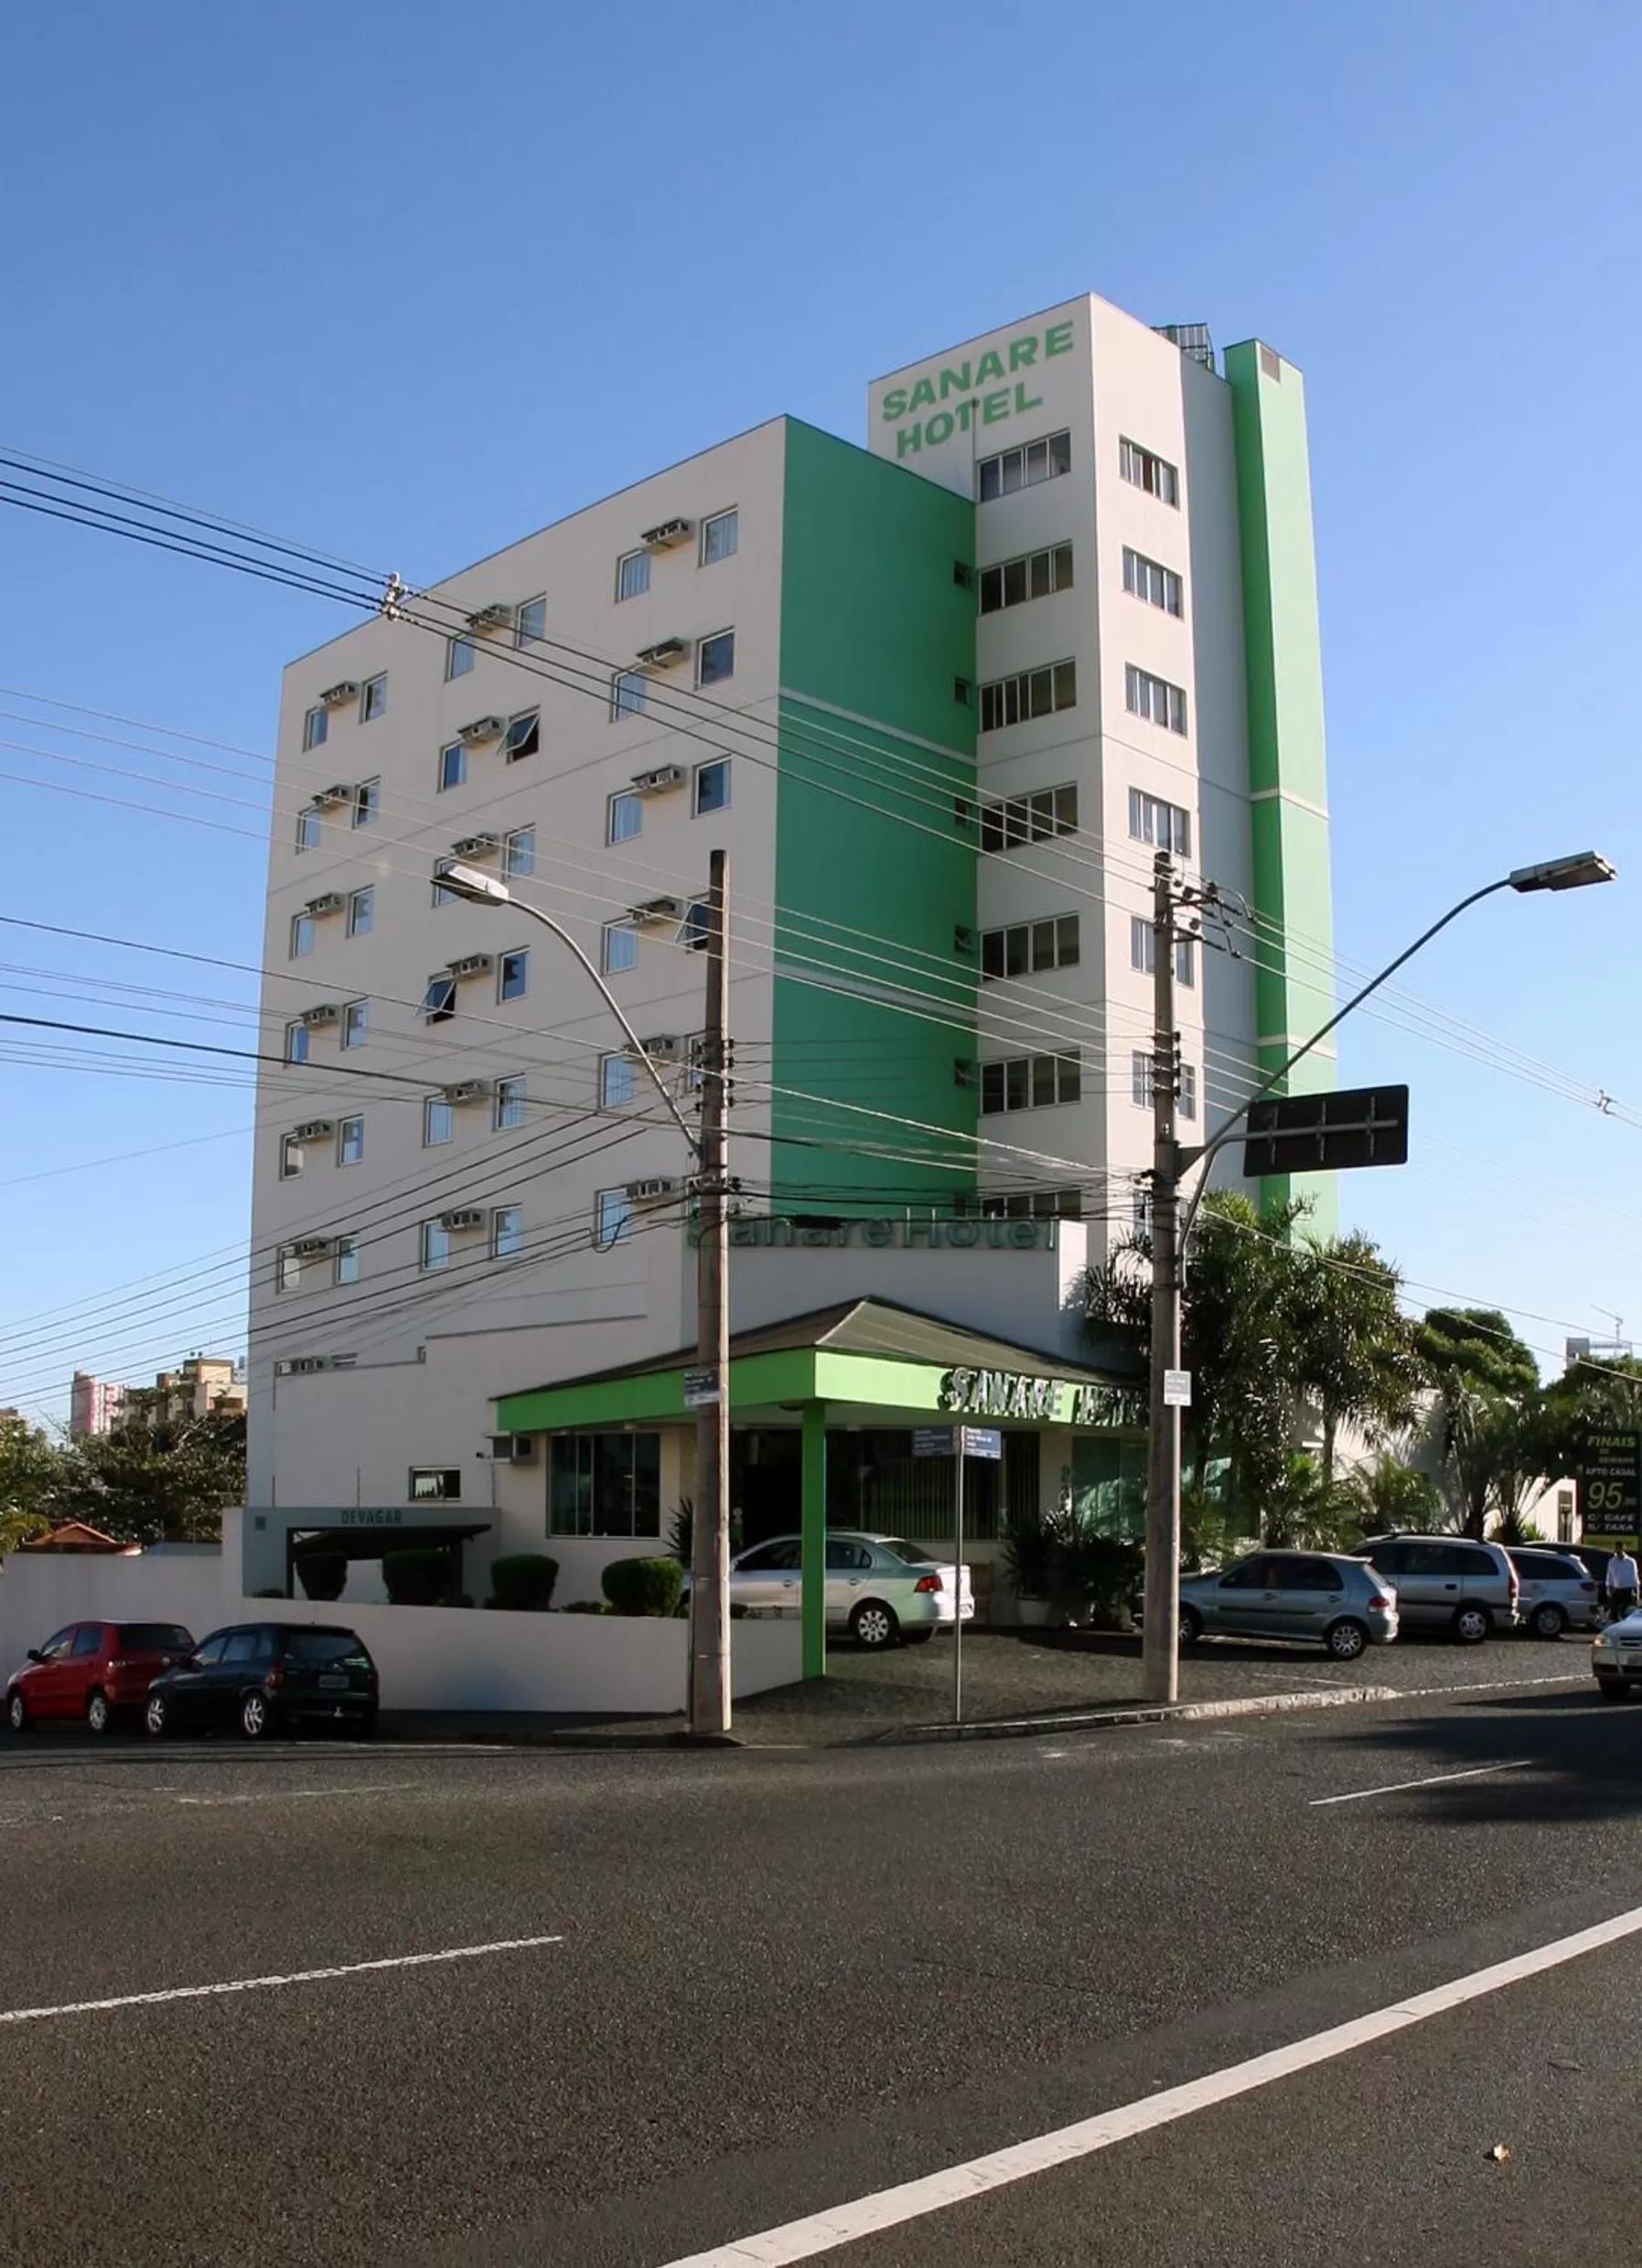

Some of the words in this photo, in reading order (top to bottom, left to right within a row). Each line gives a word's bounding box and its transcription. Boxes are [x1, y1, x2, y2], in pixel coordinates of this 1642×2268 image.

[882, 320, 1074, 423] SANARE
[896, 382, 1044, 459] HOTEL
[687, 1216, 893, 1248] anare
[938, 1366, 1067, 1419] SANARE
[1586, 1435, 1636, 1447] FINAIS
[340, 1510, 403, 1525] DEVAGAR
